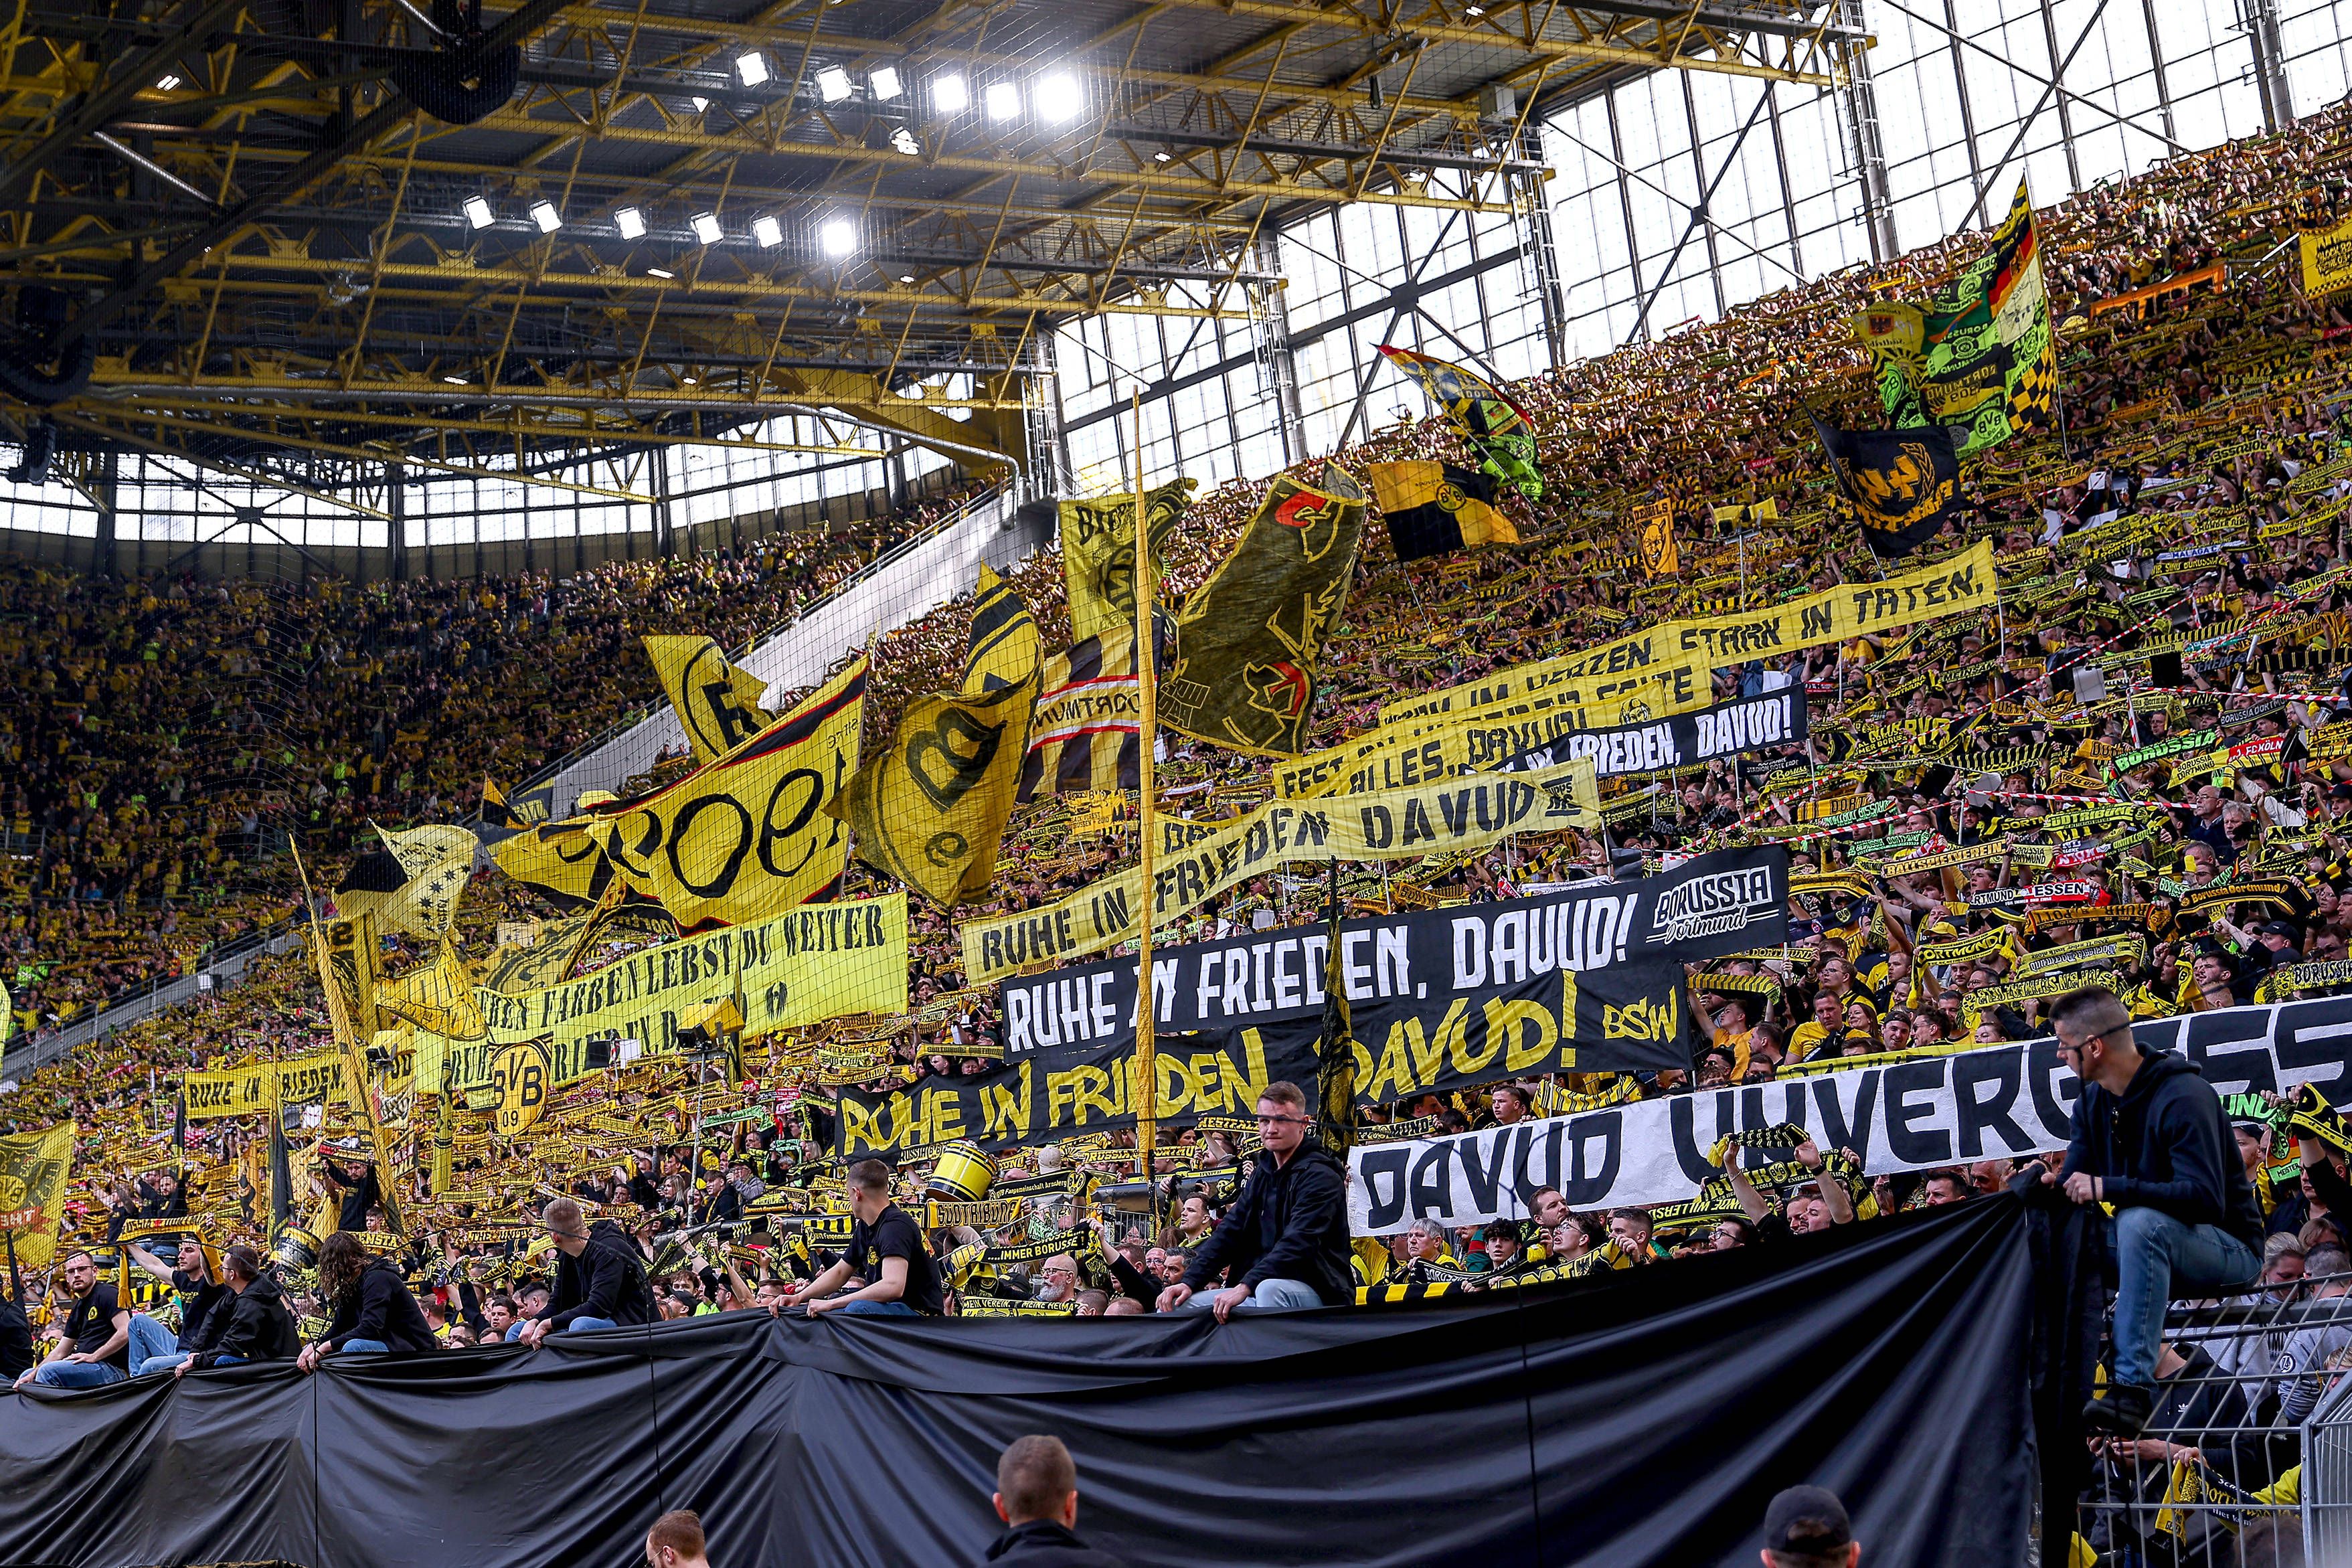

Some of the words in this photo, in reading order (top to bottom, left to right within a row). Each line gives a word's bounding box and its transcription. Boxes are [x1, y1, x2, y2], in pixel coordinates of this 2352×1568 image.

[1633, 501, 1669, 519] DEVILS
[1681, 616, 1783, 659] STARK
[1800, 600, 1833, 640] IN
[1852, 563, 1985, 626] TATEN,
[1694, 693, 1792, 760] DAVUD!
[2221, 706, 2254, 725] BORUSSIA
[1568, 722, 1681, 775] FRIEDEN,
[2115, 731, 2217, 771] BORUSSIA
[2258, 739, 2283, 752] KÖLN
[2177, 754, 2213, 773] BORUSSIA
[2177, 761, 2215, 781] DORTMUND
[2043, 806, 2134, 828] SÜDTRIBÜNE
[1155, 807, 1330, 913] FRIEDEN
[1361, 780, 1537, 849] DAVUD
[1885, 841, 2007, 875] BALLSPIELVEREIN.
[1653, 865, 1772, 928] BORUSSIA
[2035, 882, 2084, 896] ESSEN
[2191, 885, 2229, 903] Borussia
[2229, 883, 2280, 895] Dortmund
[981, 908, 1074, 972] RUHE
[1091, 886, 1130, 939] IN
[1665, 905, 1748, 946] Dortmund
[541, 959, 639, 1028] FARBEN
[645, 929, 733, 995] LEBST
[739, 923, 773, 970] DU
[783, 904, 886, 957] WEITER
[1006, 970, 1117, 1053] RUHE
[1197, 925, 1428, 1020] FRIEDEN,
[1451, 893, 1639, 990] DAVUD!
[1602, 985, 1679, 1045] BSW
[189, 1079, 232, 1109] RUHE
[244, 1075, 260, 1104] IN
[494, 1051, 543, 1110] BVB
[502, 1110, 519, 1128] 09
[841, 1082, 967, 1156] RUHE
[979, 1059, 1035, 1142] IN
[1068, 1173, 1082, 1188] BVB
[1359, 1111, 1623, 1229] DAVUD
[2276, 1163, 2300, 1177] MEISTER
[1004, 1182, 1045, 1195] Fangemeinschaft
[1044, 1179, 1068, 1189] Arnsberg
[938, 1199, 1021, 1226] SÜDTRIBÜNE
[470, 1229, 491, 1242] THE
[500, 1227, 533, 1241] UNITY
[1034, 1237, 1078, 1257] BORUSSE
[963, 1300, 979, 1308] MEIN
[1022, 1301, 1047, 1310] MEINE
